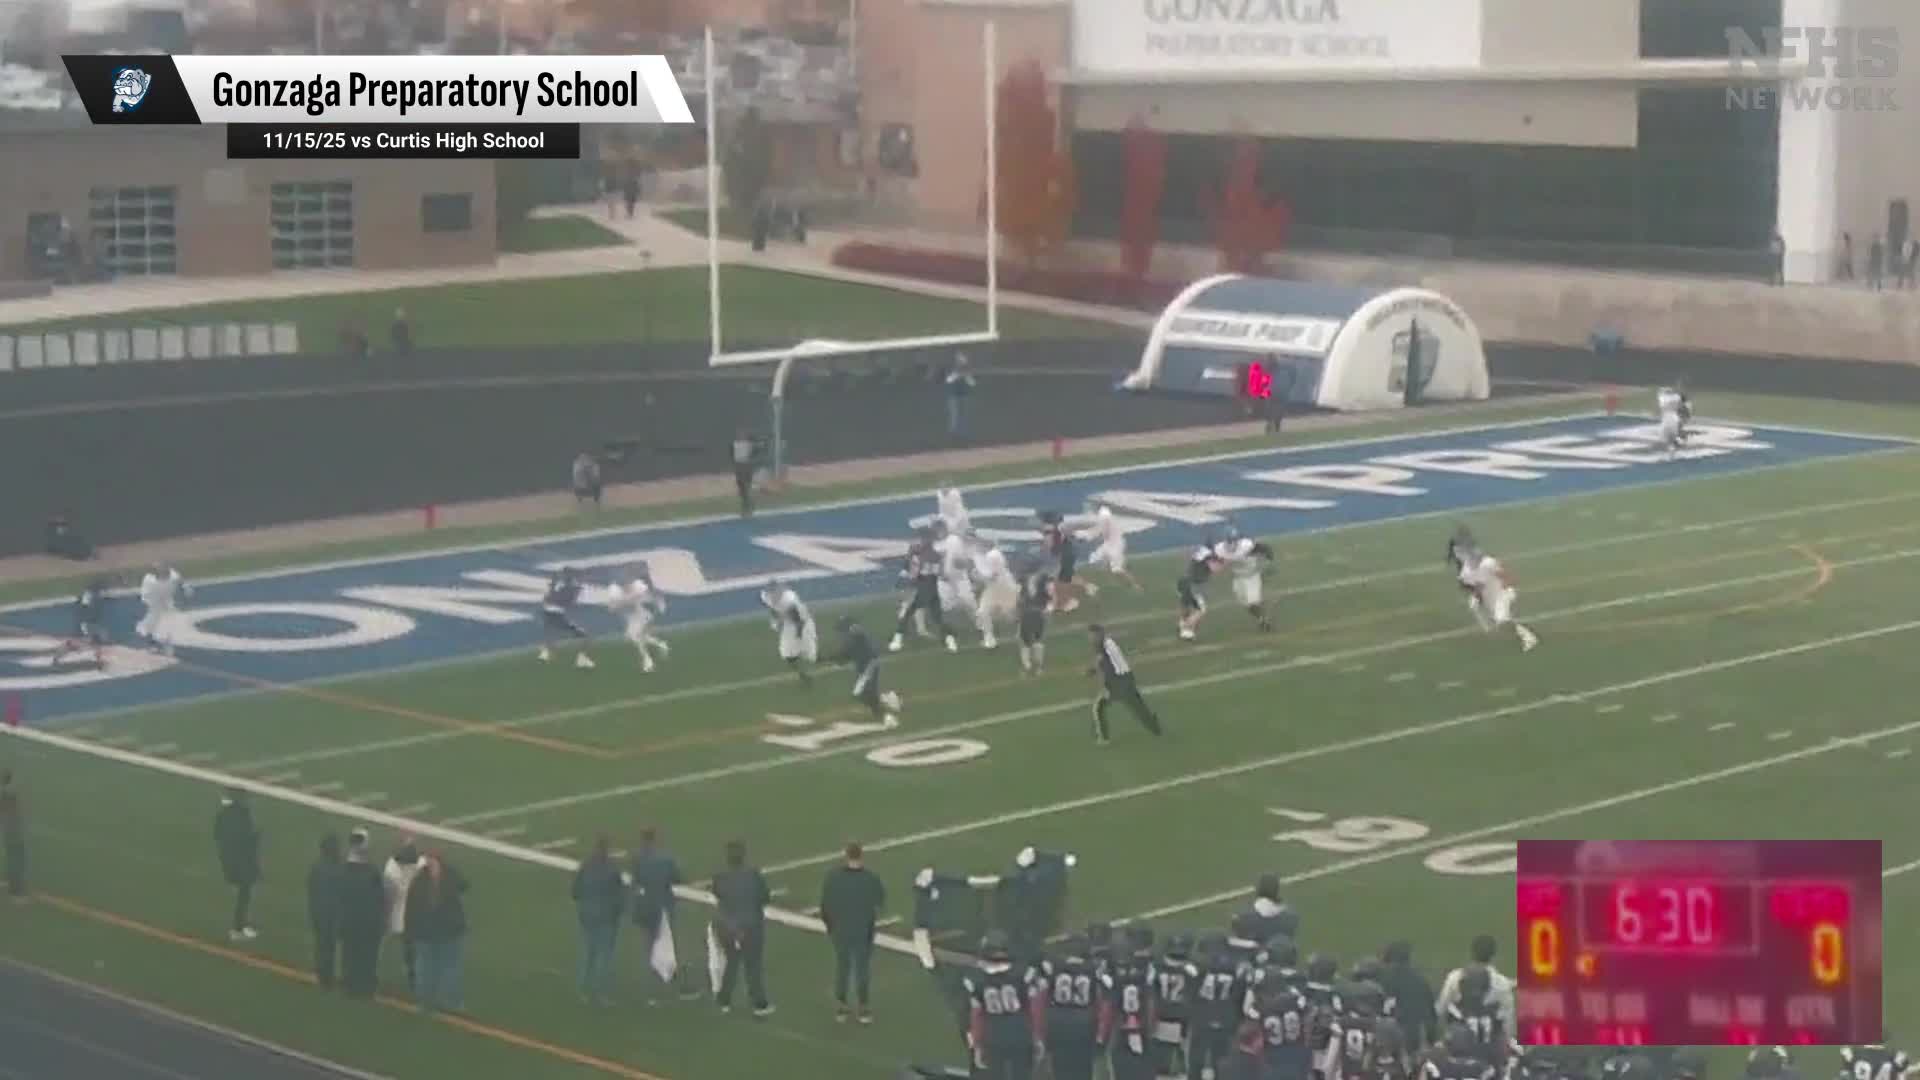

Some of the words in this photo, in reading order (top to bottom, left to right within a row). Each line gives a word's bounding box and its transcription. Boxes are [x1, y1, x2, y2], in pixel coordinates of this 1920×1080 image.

[1530, 918, 1558, 976] 0
[1813, 923, 1843, 984] 0
[1200, 973, 1233, 1000] 47
